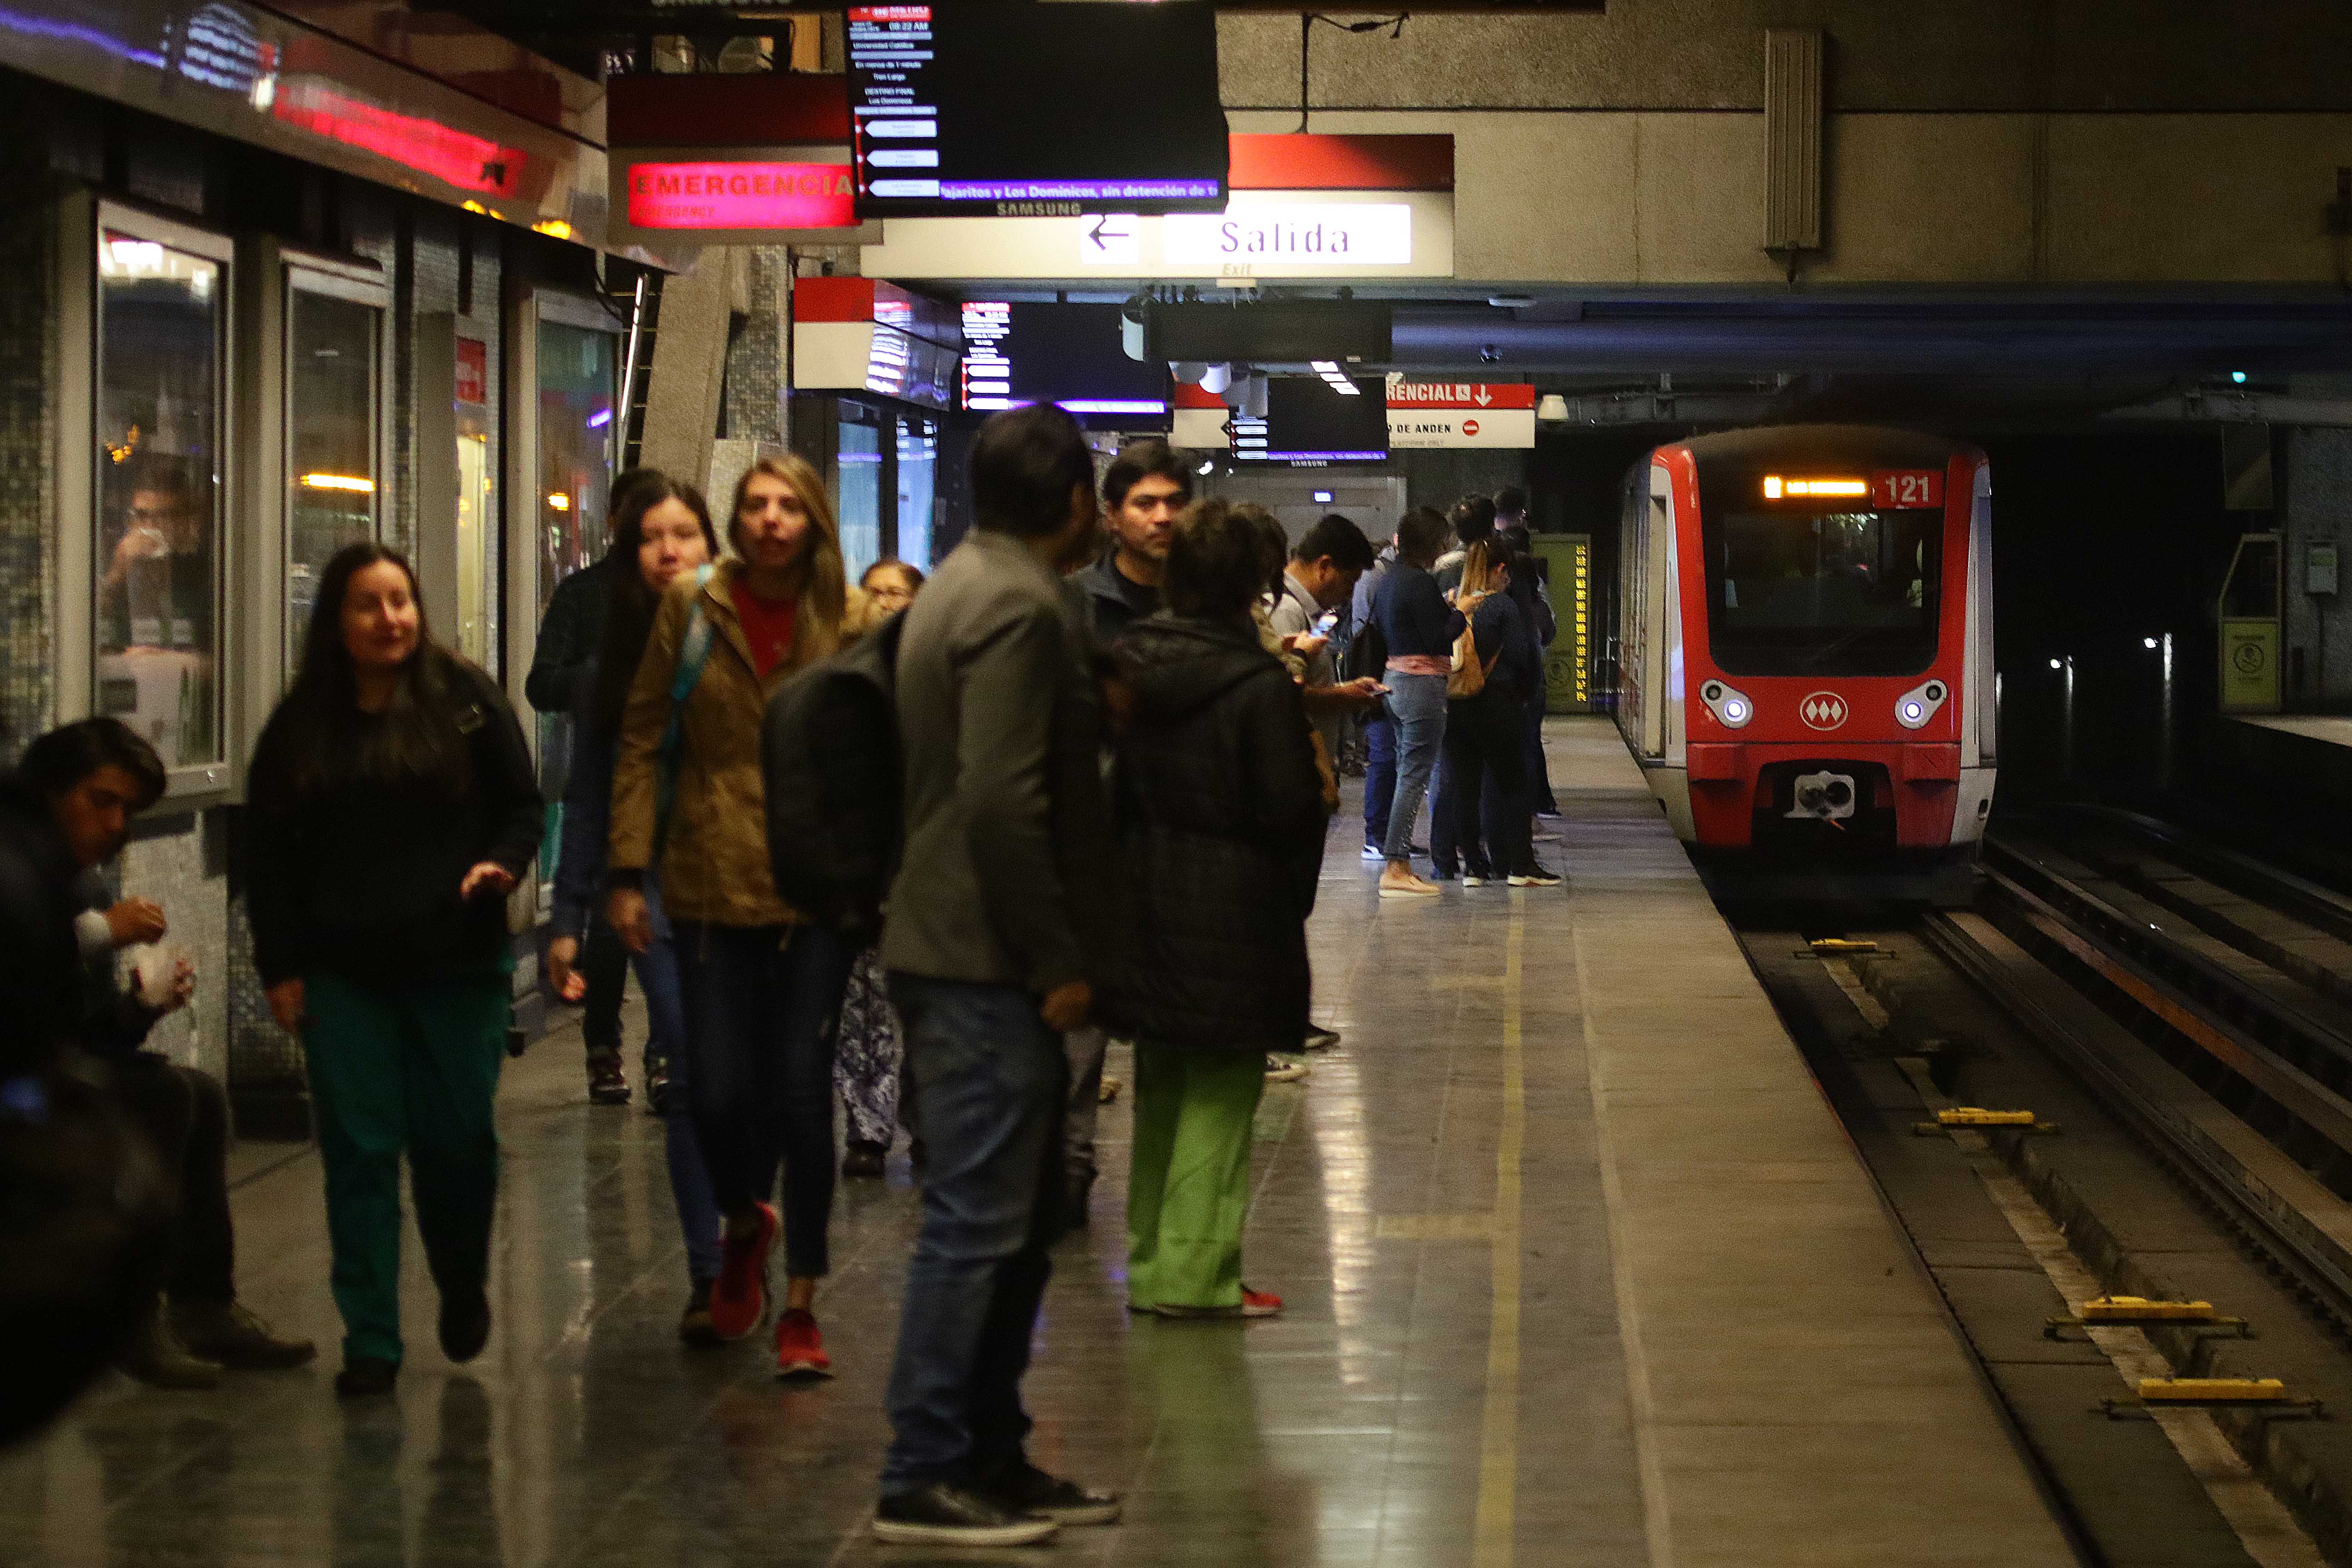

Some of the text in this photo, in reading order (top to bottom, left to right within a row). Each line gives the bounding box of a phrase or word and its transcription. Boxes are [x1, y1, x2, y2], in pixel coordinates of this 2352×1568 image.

[637, 175, 854, 196] EMERGENCIA
[993, 189, 1002, 199] y
[1004, 186, 1026, 198] Los
[1029, 185, 1098, 199] Dominicos,
[1102, 186, 1120, 197] sin
[1122, 185, 1186, 197] detención
[1189, 185, 1205, 197] de
[997, 202, 1081, 216] SAMSUNG
[1221, 222, 1348, 252] Salida
[1397, 424, 1410, 433] DE
[1415, 424, 1451, 433] ANDEN
[1885, 475, 1929, 503] 121
